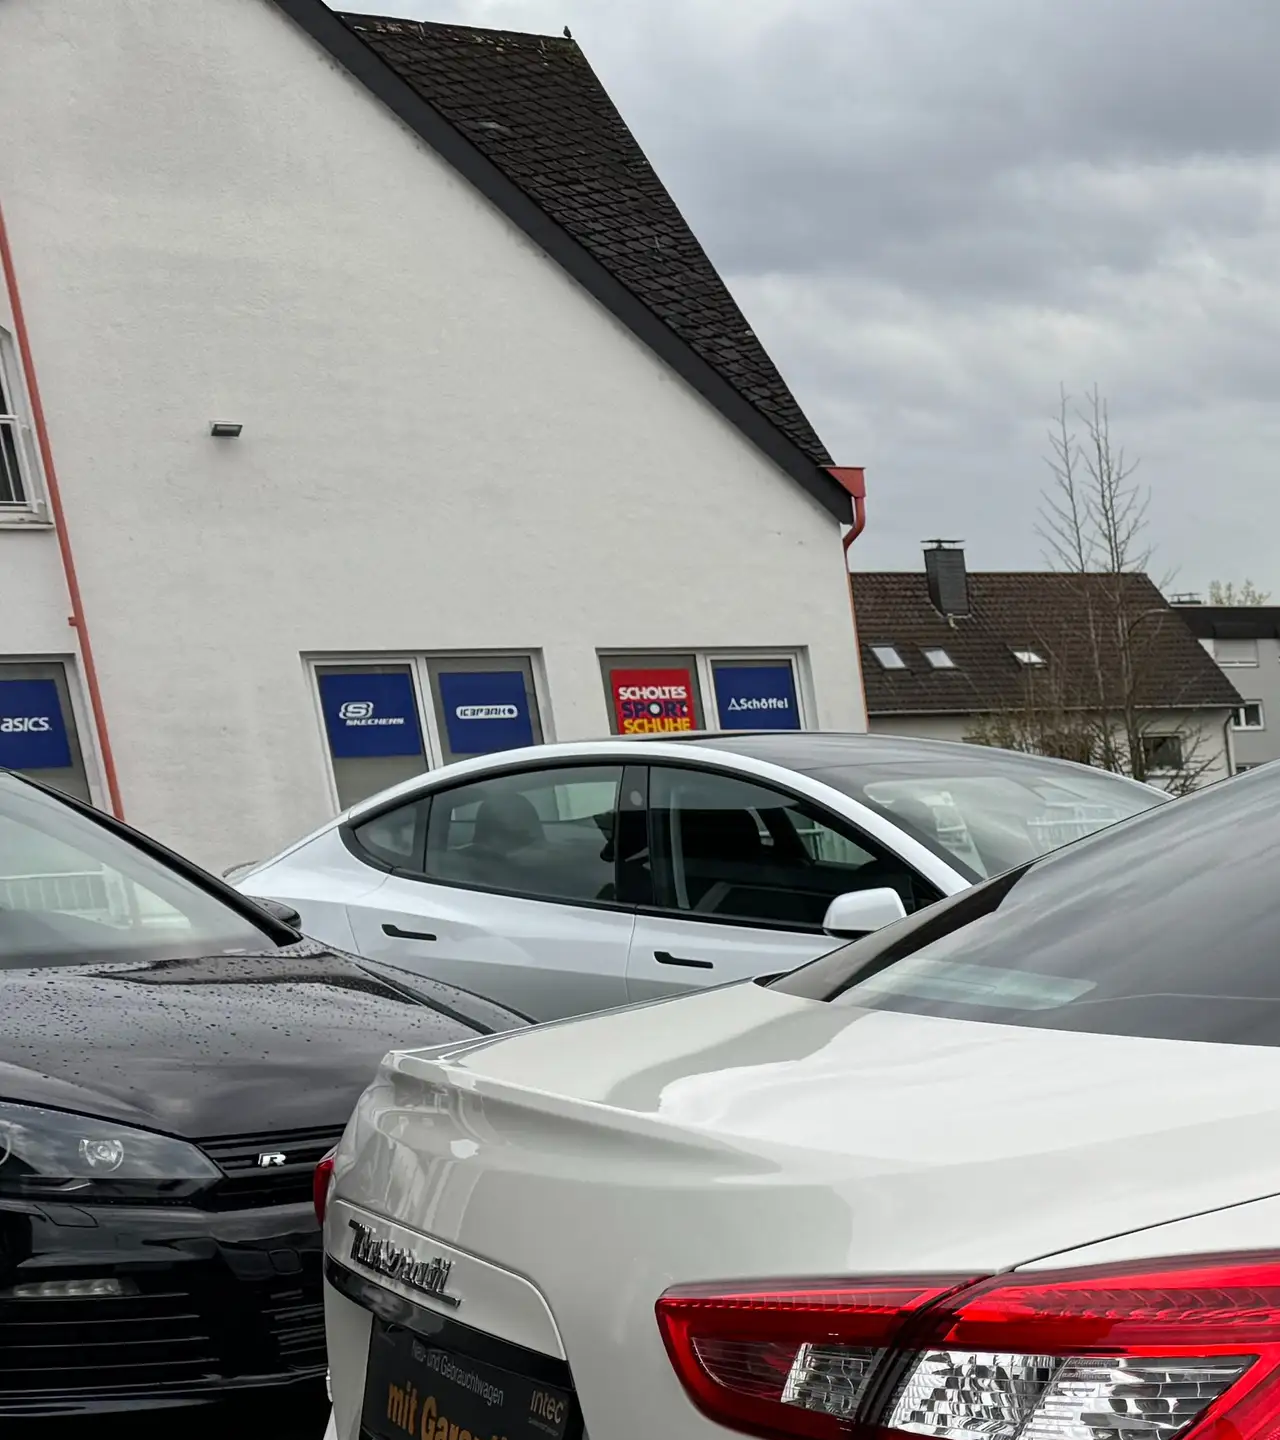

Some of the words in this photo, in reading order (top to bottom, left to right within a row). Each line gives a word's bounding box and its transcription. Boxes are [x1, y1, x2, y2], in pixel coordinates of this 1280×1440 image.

[618, 686, 687, 700] SCHOLTES
[621, 701, 688, 718] SPORT
[740, 698, 788, 710] Schöffel
[0, 717, 49, 732] asics
[346, 717, 404, 726] SKECHERS
[623, 718, 691, 733] SCHUHE
[259, 1152, 286, 1168] R
[440, 1355, 504, 1407] Gebrauchtwagen
[387, 1380, 419, 1435] mit
